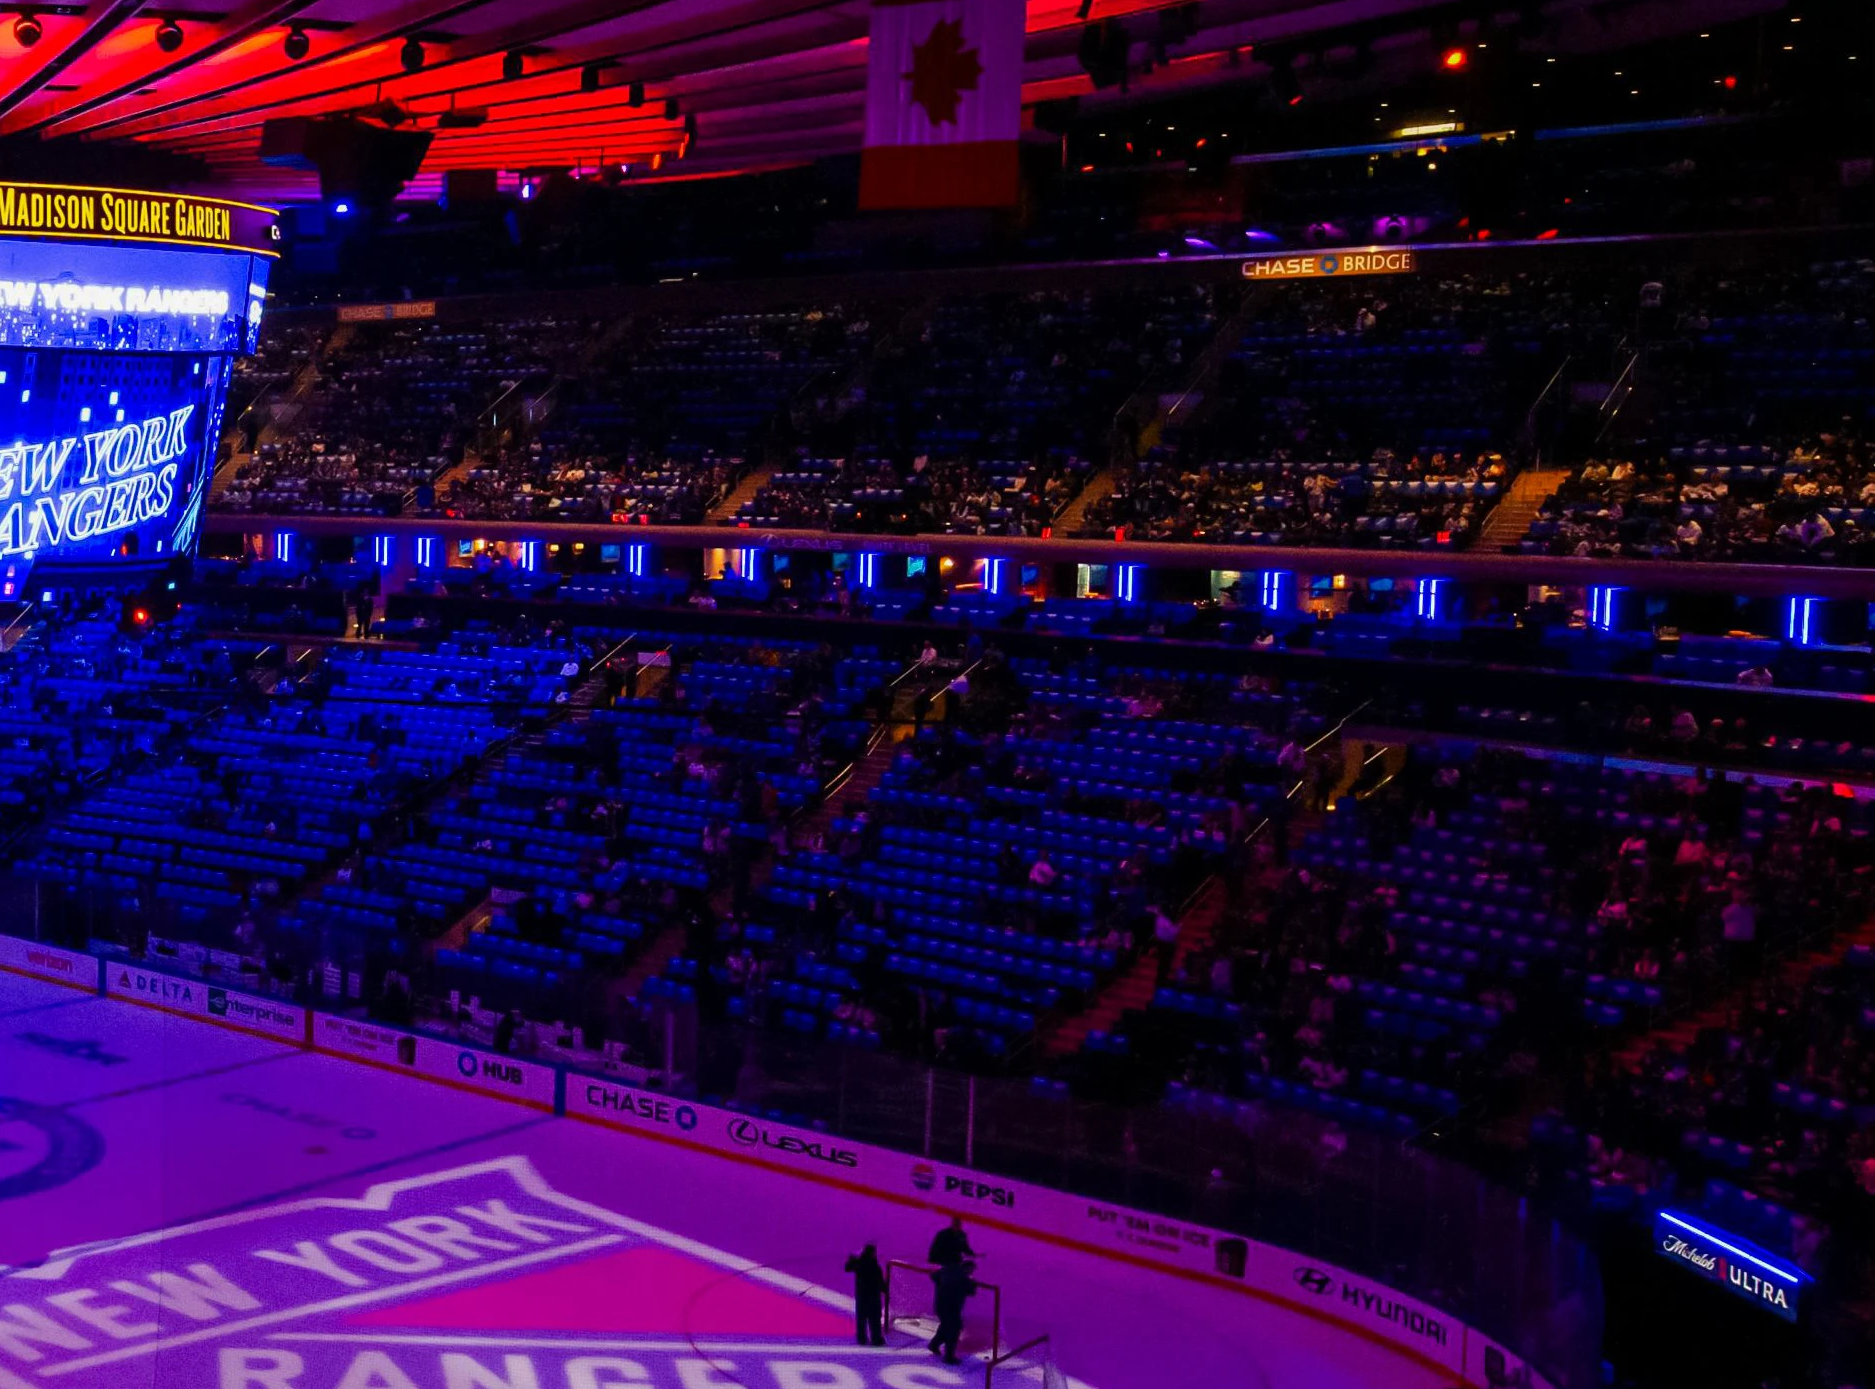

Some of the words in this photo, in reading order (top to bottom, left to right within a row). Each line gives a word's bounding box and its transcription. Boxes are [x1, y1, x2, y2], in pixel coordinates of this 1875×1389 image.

[101, 193, 171, 235] SQUARE
[175, 199, 231, 241] GARDEN
[1242, 257, 1316, 277] CHASE
[1343, 253, 1411, 272] BRIDGE
[39, 281, 126, 312] YORK
[126, 285, 230, 316] RANGERS
[79, 404, 195, 485] YORK
[781, 538, 843, 551] LEXUS
[136, 973, 193, 1003] DELTA
[483, 1059, 522, 1085] HUB
[586, 1085, 670, 1123] CHASE
[762, 1130, 858, 1168] LEXUS
[944, 1175, 1015, 1208] PEPSI
[256, 1197, 593, 1288] YORK
[1663, 1235, 1715, 1271] Michelob
[1729, 1265, 1789, 1309] ULTRA
[1342, 1282, 1447, 1346] HYUNDAI
